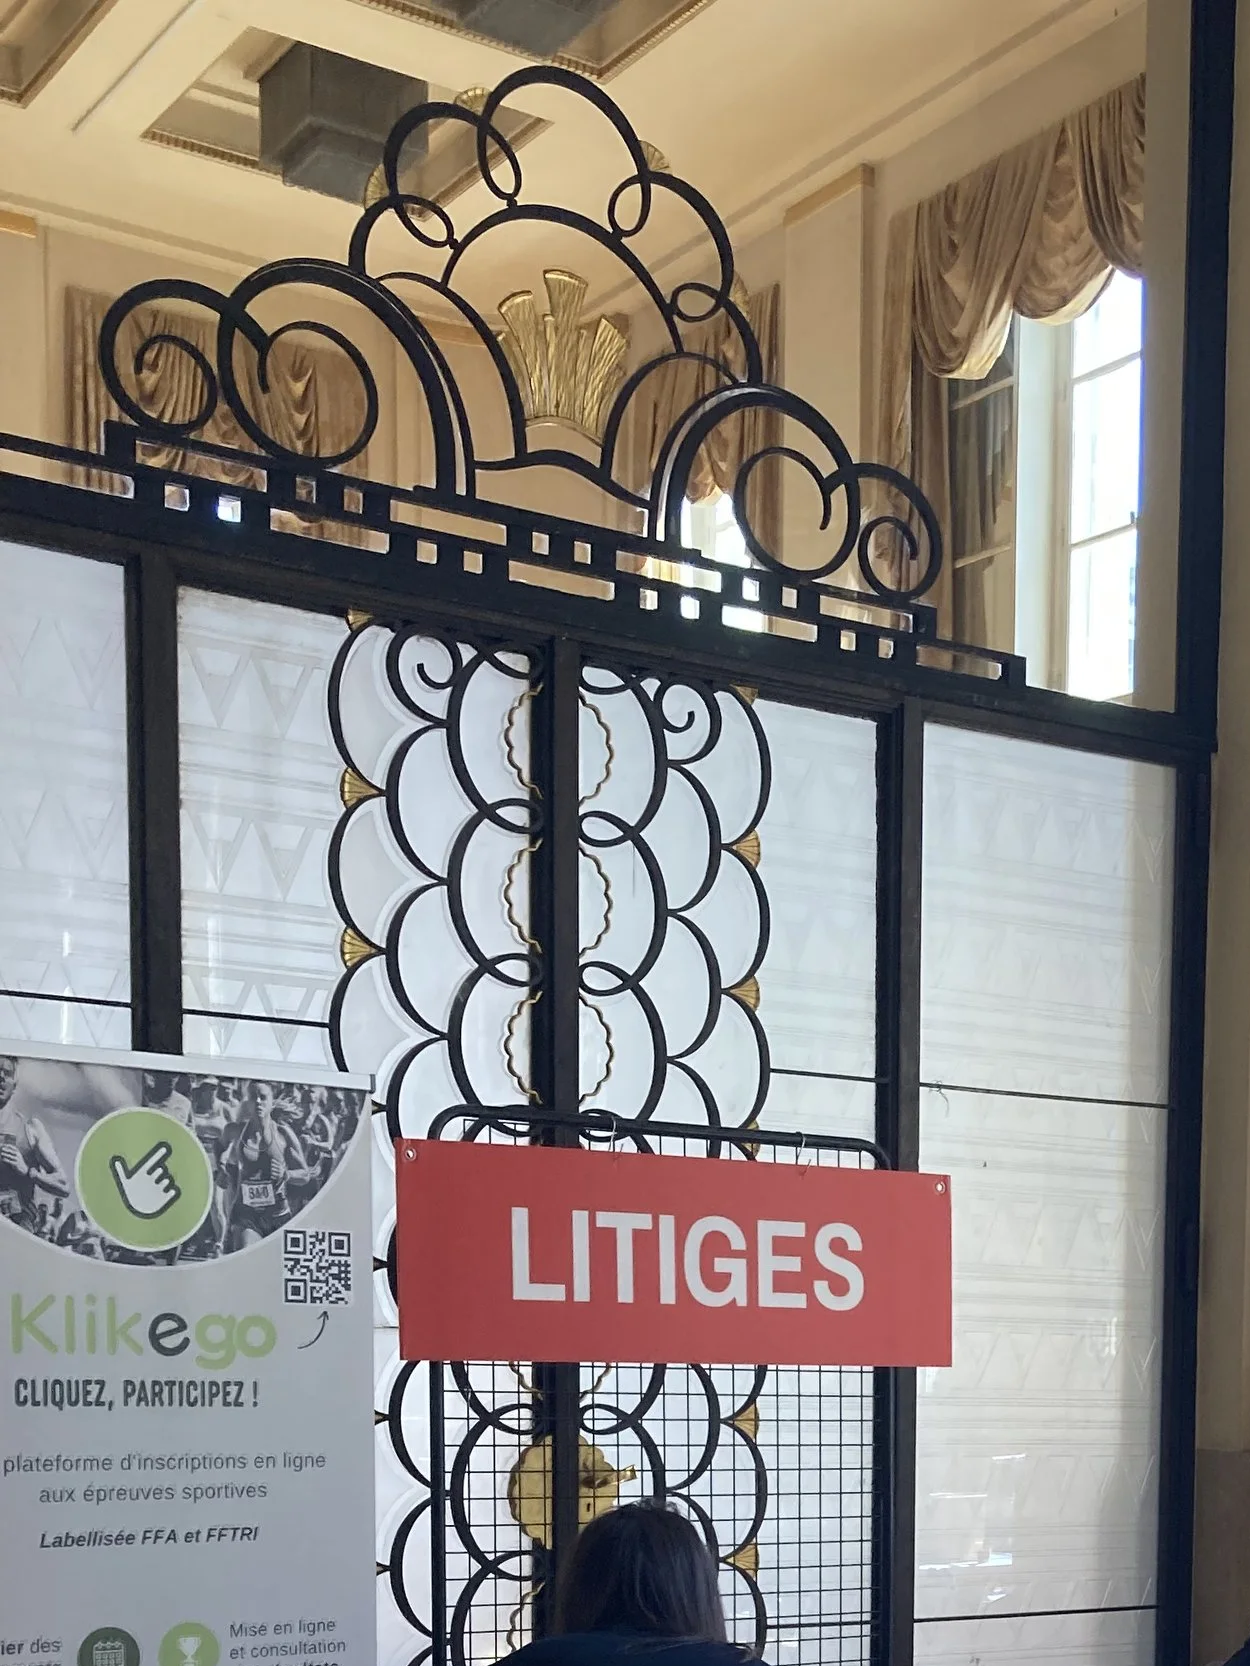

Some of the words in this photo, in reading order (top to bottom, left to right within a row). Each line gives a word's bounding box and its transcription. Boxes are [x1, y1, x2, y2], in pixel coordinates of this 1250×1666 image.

[510, 1206, 864, 1312] LITIGES
[10, 1293, 277, 1370] Klikego
[14, 1378, 114, 1411] CLIQUEZ,
[123, 1379, 245, 1408] PARTICIPEZ
[3, 1453, 113, 1476] plateforme
[120, 1452, 247, 1473] d'inscriptions
[254, 1456, 276, 1469] en
[283, 1451, 326, 1471] ligne
[39, 1487, 76, 1503] aux
[83, 1483, 175, 1505] épreuves
[182, 1482, 268, 1503] sportives
[40, 1530, 135, 1549] Labellisée
[142, 1529, 178, 1545] FFA
[184, 1528, 200, 1544] et
[205, 1526, 259, 1543] FFTRI
[229, 1621, 268, 1639] Mise
[273, 1622, 294, 1636] en
[298, 1619, 336, 1637] ligne
[30, 1637, 62, 1653] des
[229, 1645, 246, 1660] et
[250, 1639, 347, 1659] consultation
